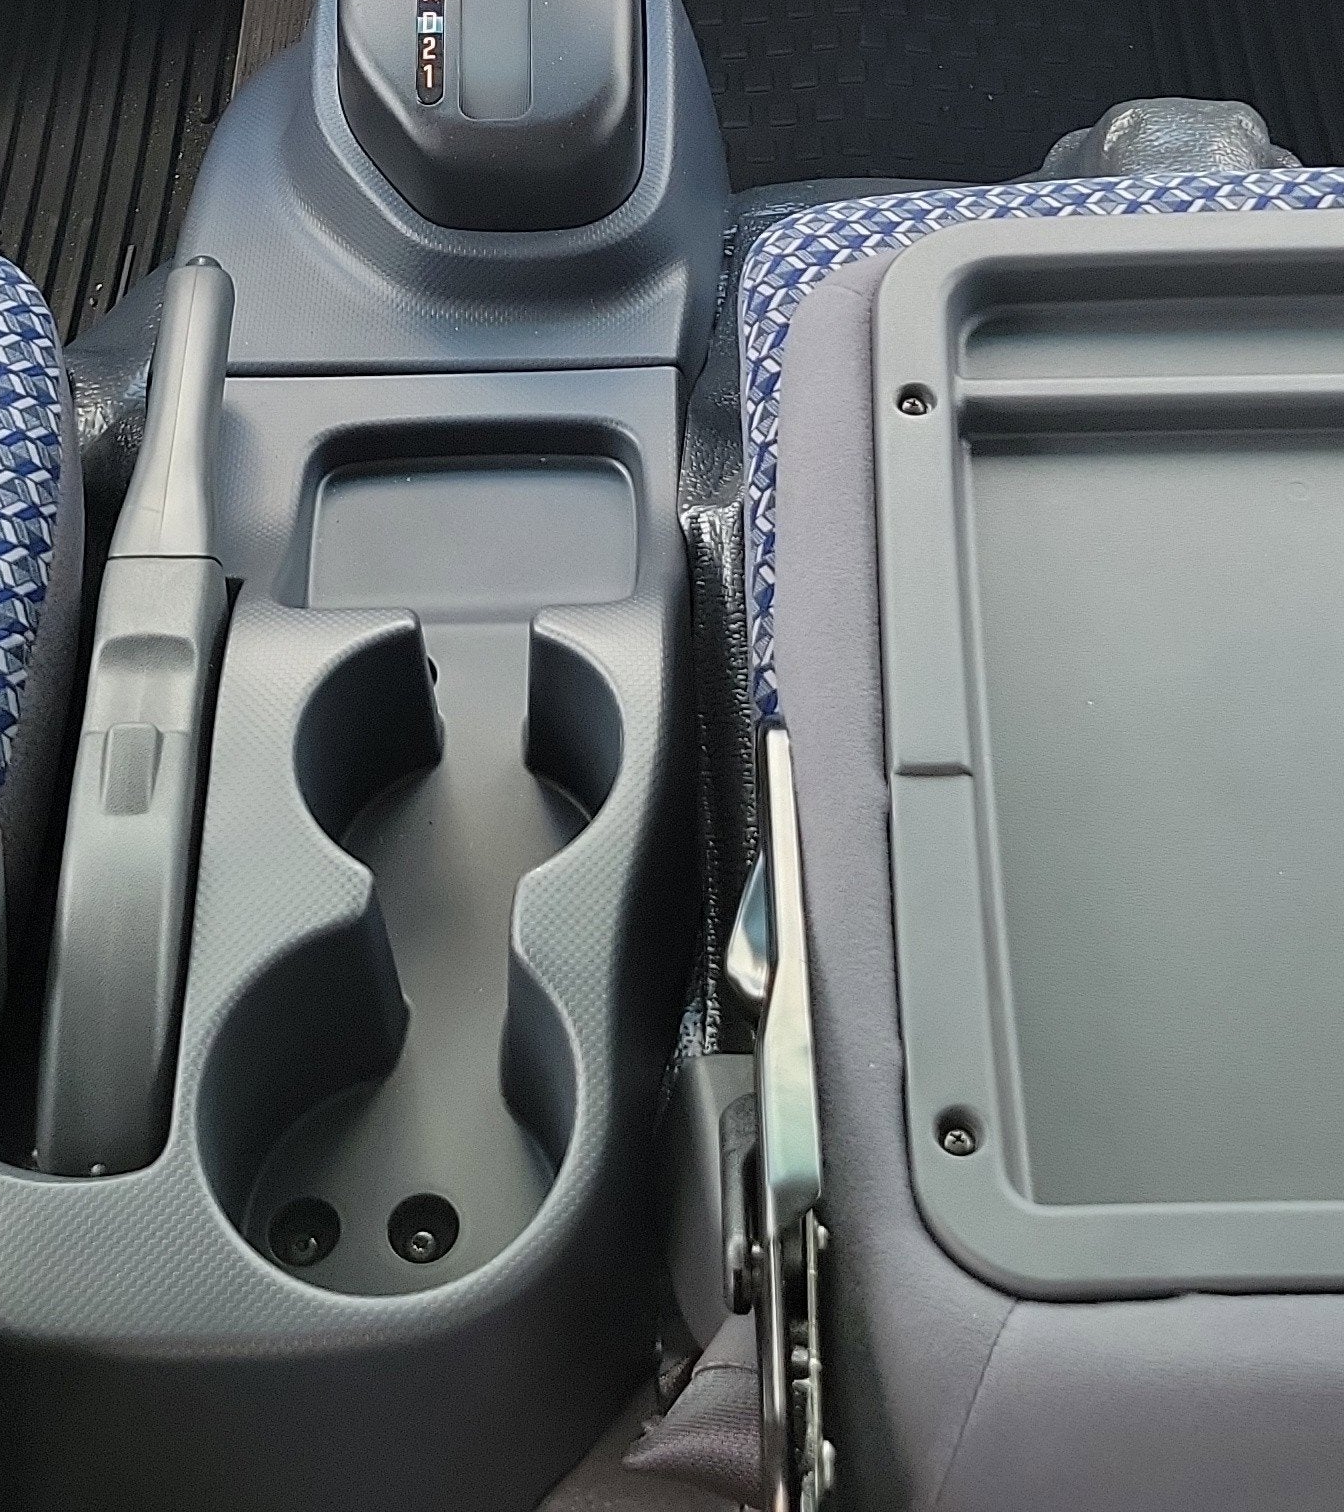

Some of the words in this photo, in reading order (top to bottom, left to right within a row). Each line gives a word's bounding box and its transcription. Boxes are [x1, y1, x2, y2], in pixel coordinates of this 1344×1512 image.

[422, 11, 437, 33] D
[422, 36, 436, 60] 2
[423, 64, 433, 88] 1
